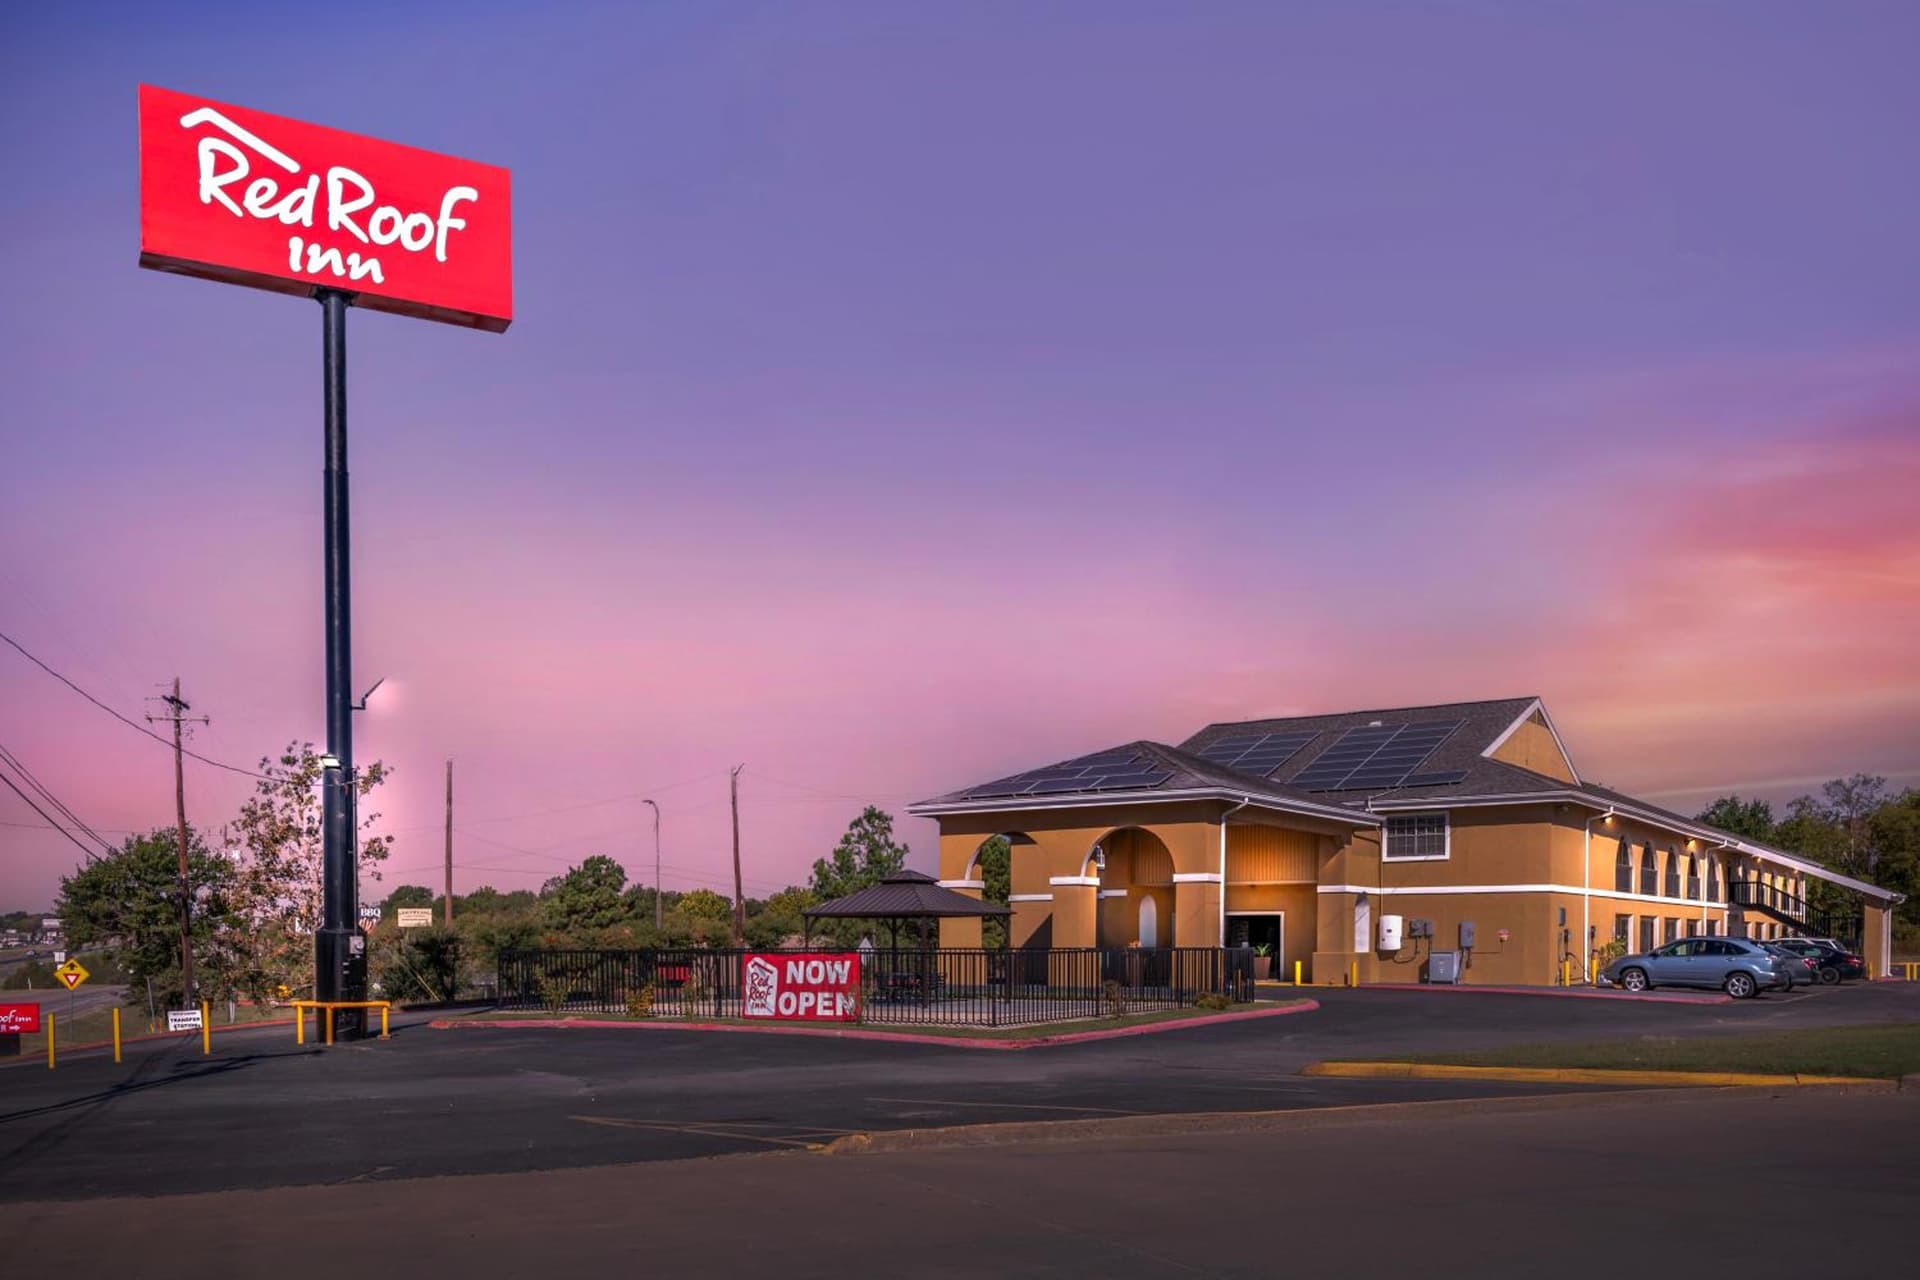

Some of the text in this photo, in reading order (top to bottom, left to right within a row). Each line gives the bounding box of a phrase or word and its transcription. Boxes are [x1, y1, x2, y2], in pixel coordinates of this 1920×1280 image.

[360, 908, 381, 918] BBQ
[750, 972, 770, 987] Red
[786, 960, 851, 985] NOW
[748, 985, 774, 1003] Roof
[778, 991, 856, 1016] OPEN
